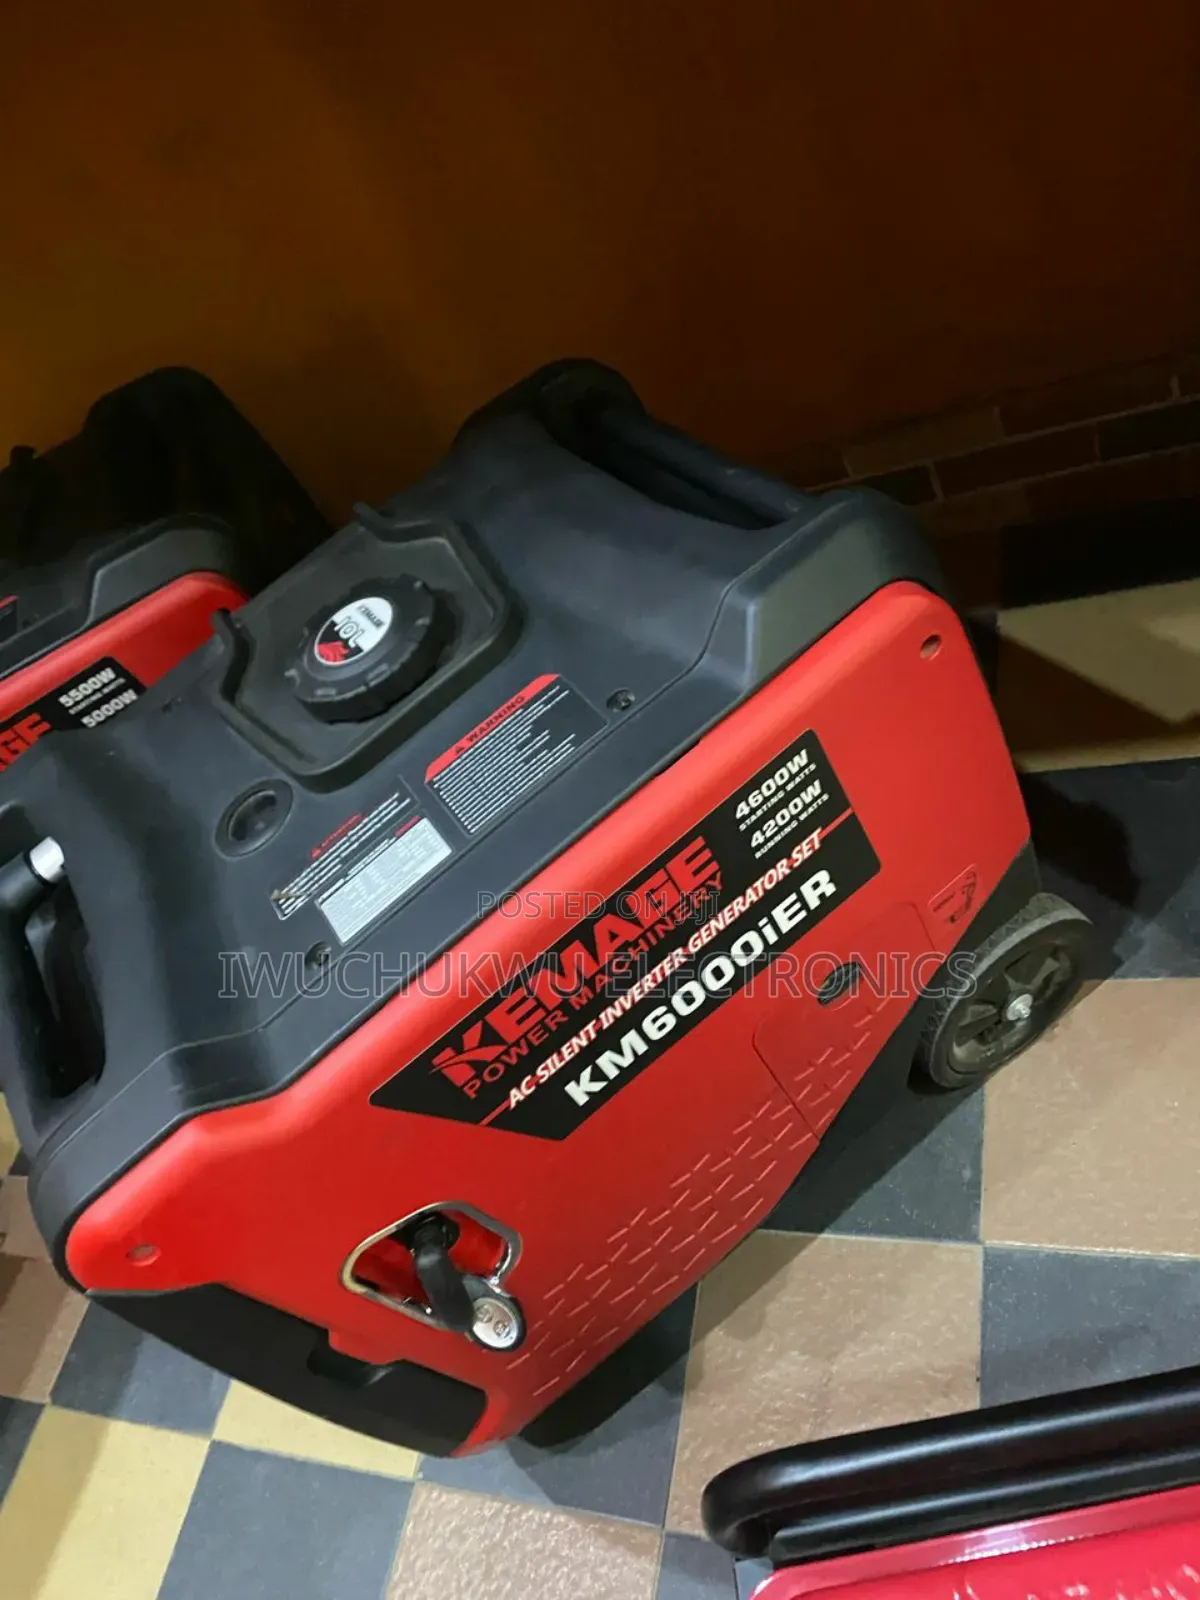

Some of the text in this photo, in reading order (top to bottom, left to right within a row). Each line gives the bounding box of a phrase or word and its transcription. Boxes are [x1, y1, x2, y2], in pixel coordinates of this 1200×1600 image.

[58, 667, 116, 707] 5500W
[80, 689, 138, 728] 5000W
[467, 695, 525, 742] WARNING
[735, 748, 809, 820] 4600W
[739, 762, 817, 832] STARTING WATTS
[751, 779, 822, 848] 4200W
[754, 793, 829, 859] RUNNING WATTS
[429, 836, 721, 1087] KEMAGE
[462, 1010, 569, 1099] POWER
[568, 871, 722, 1011] MACHINERY
[564, 869, 837, 1107] KM6000iER
